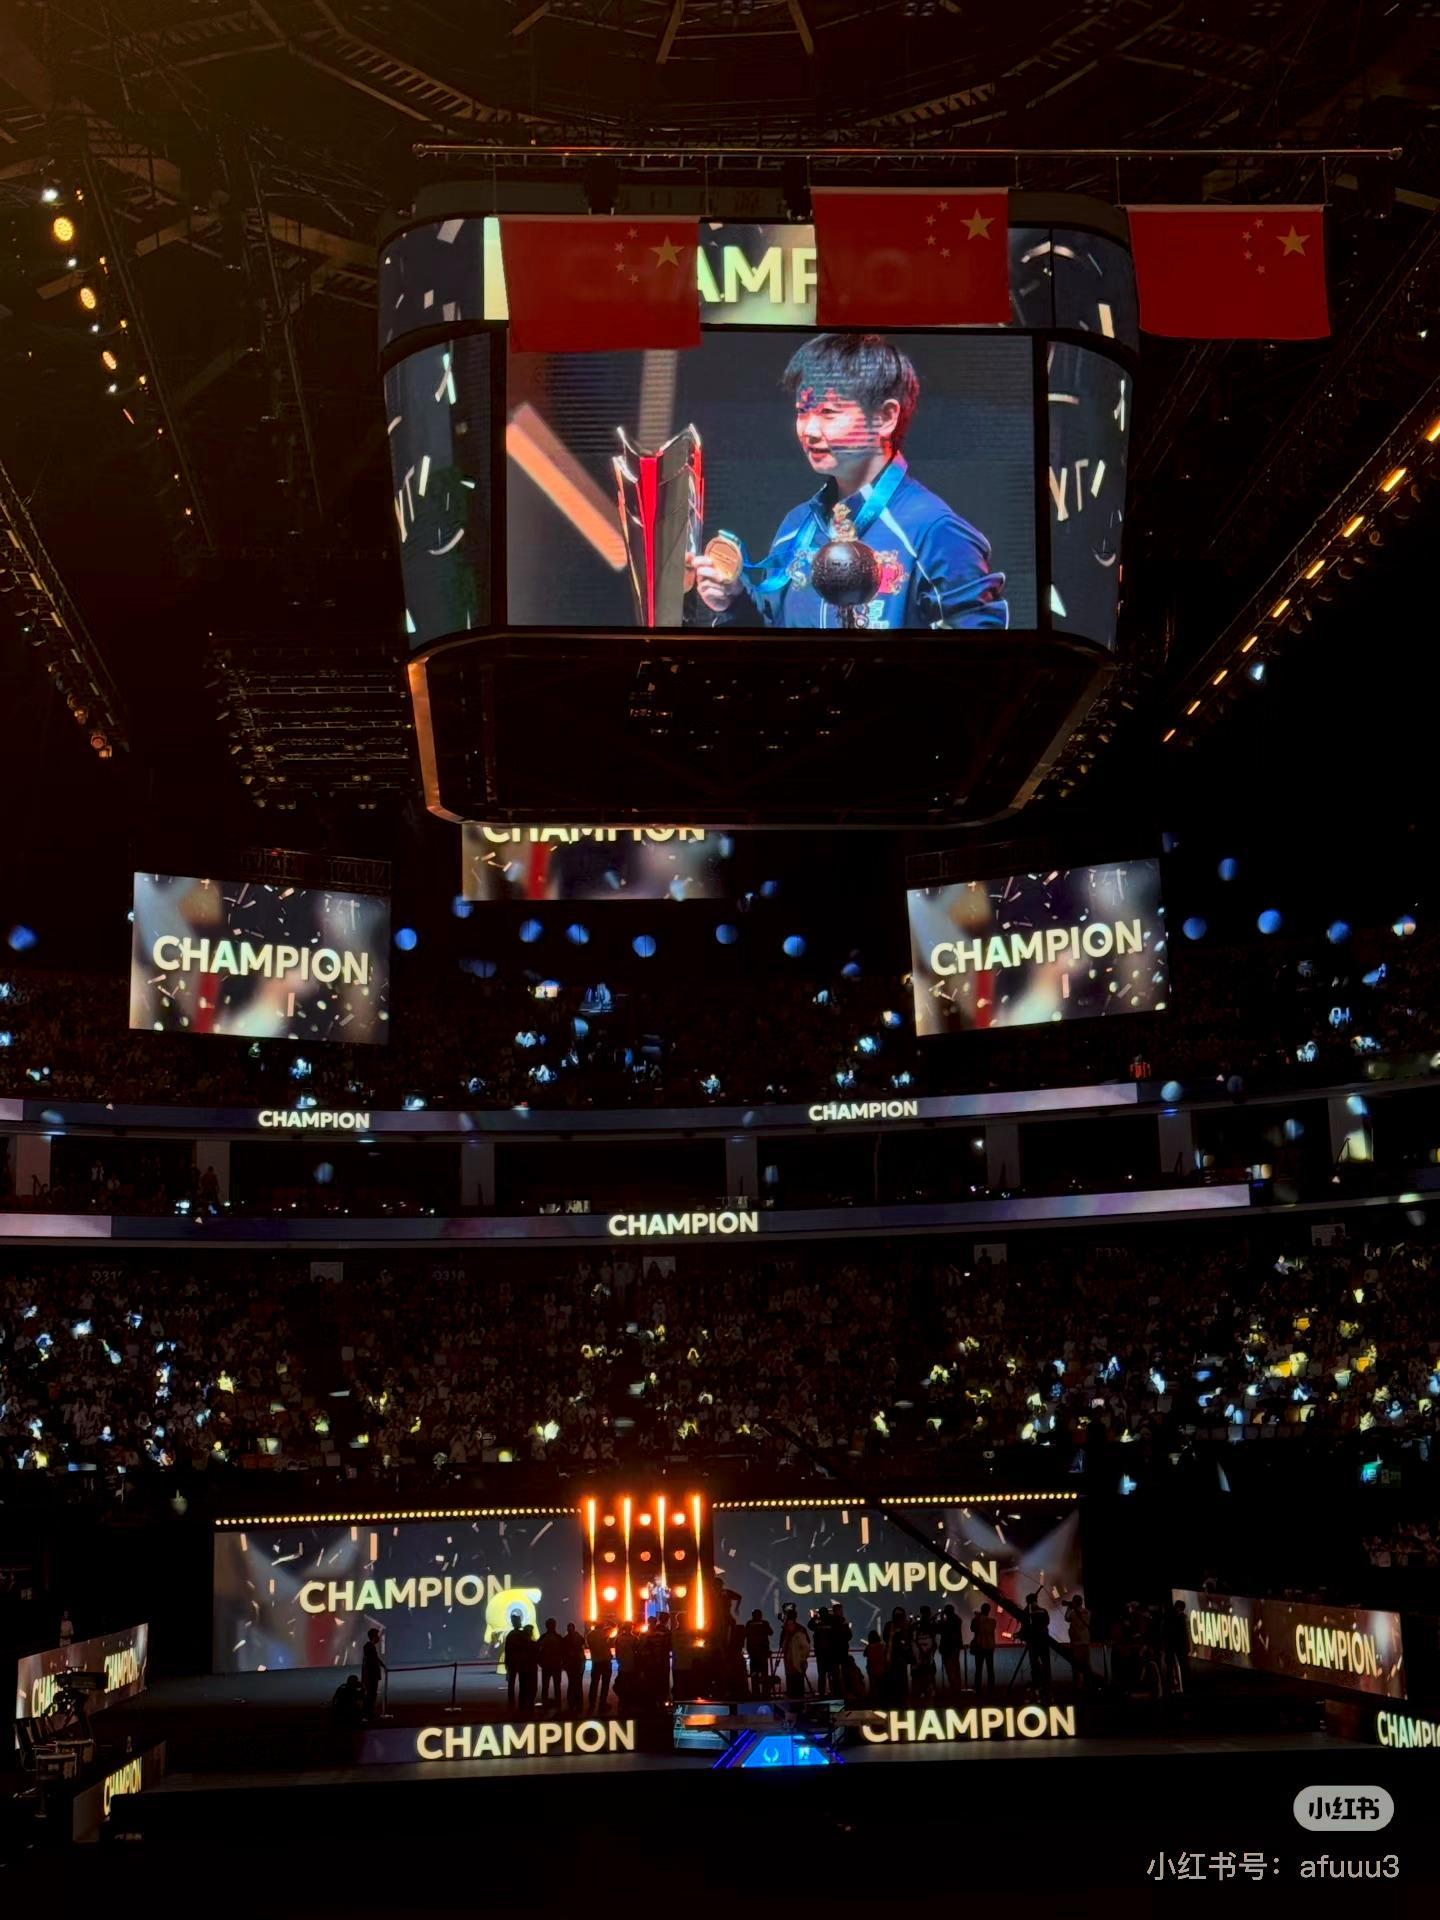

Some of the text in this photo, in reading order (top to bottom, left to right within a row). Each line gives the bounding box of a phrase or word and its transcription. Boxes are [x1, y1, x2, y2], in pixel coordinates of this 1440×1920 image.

[152, 935, 369, 985] CHAMPION
[930, 919, 1143, 976] CHAMPION
[258, 1110, 370, 1129] CHAMPION
[808, 1100, 918, 1121] CHAMPION
[608, 1211, 759, 1237] CHAMPION
[786, 1560, 998, 1594] CHAMPION
[1190, 1609, 1250, 1654] CHAMPION
[1295, 1624, 1378, 1678] CHAMPION
[416, 1719, 635, 1760] CHAMPION
[862, 1705, 1076, 1743] CHAMPION
